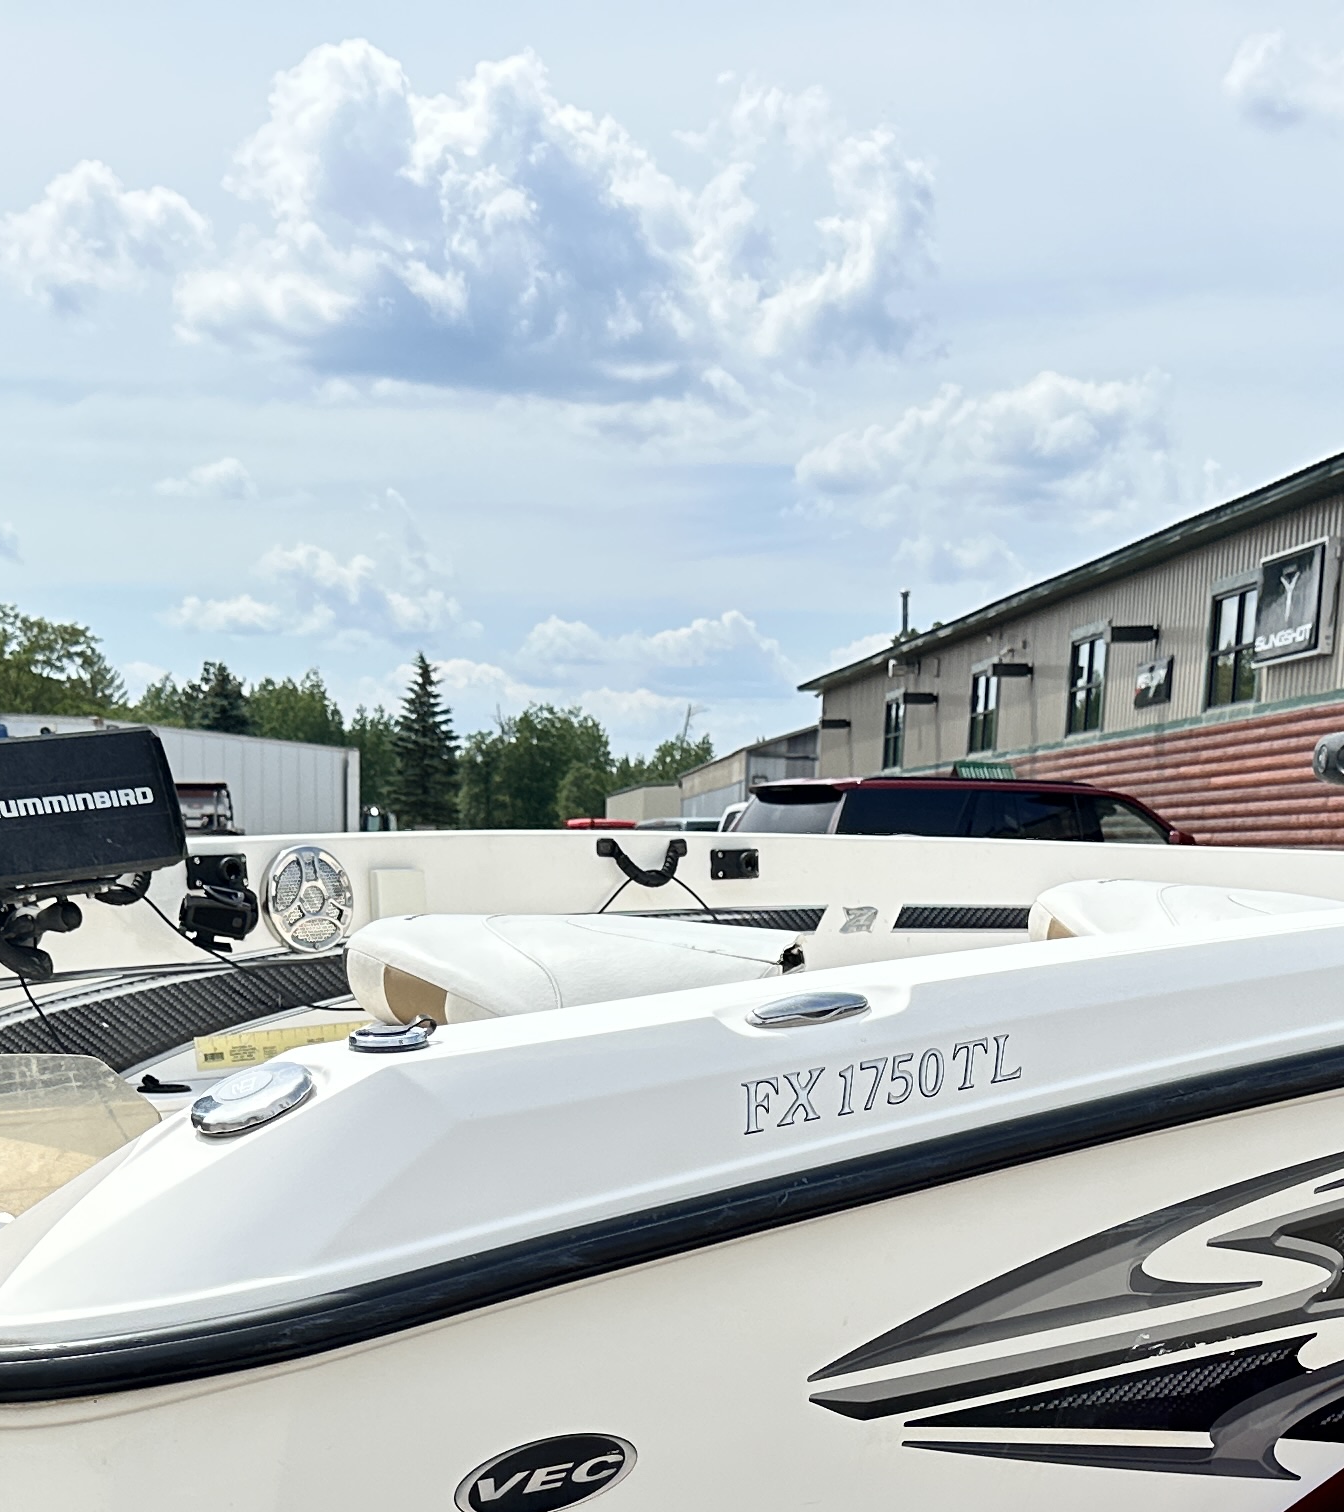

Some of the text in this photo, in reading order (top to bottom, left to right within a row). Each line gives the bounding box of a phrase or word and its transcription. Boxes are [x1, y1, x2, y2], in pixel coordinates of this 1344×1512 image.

[1254, 623, 1313, 652] SLINGSHOT
[740, 1066, 826, 1136] FX
[476, 1453, 624, 1503] VEC
